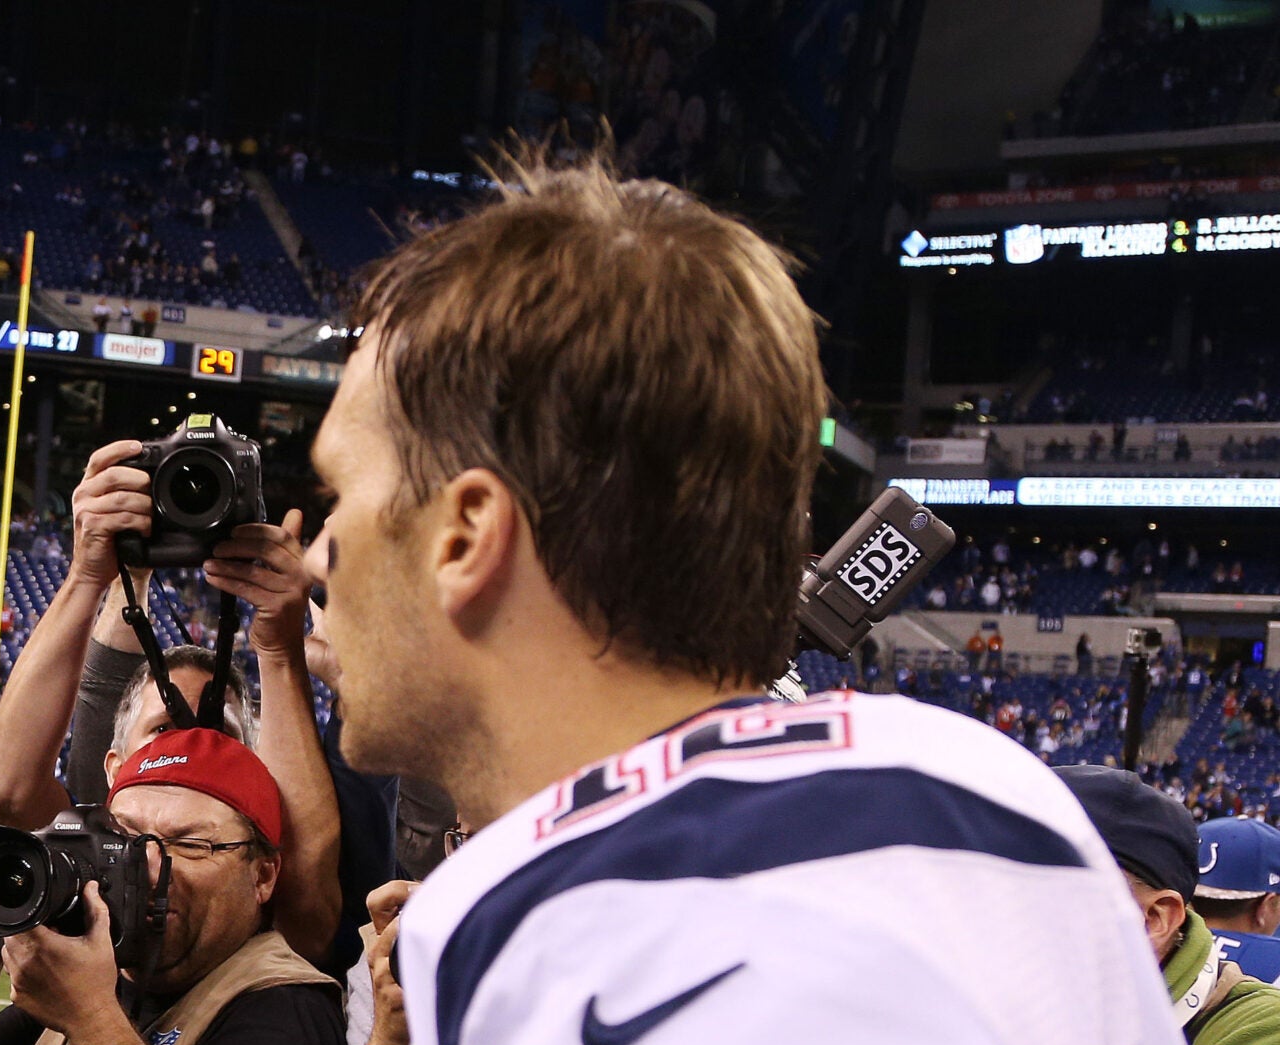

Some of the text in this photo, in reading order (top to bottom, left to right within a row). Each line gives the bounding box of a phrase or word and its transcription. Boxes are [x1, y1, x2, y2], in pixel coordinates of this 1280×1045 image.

[110, 341, 158, 360] meijer
[200, 348, 234, 374] 29
[186, 431, 215, 440] Canon
[1101, 480, 1135, 491] AND
[1141, 480, 1184, 491] EASY
[1190, 480, 1245, 491] PLACE
[1252, 480, 1274, 491] TO
[1086, 494, 1115, 505] THE
[1181, 494, 1223, 505] SEAT
[847, 530, 910, 597] SDS
[137, 755, 188, 774] Indians
[54, 822, 82, 831] Canon
